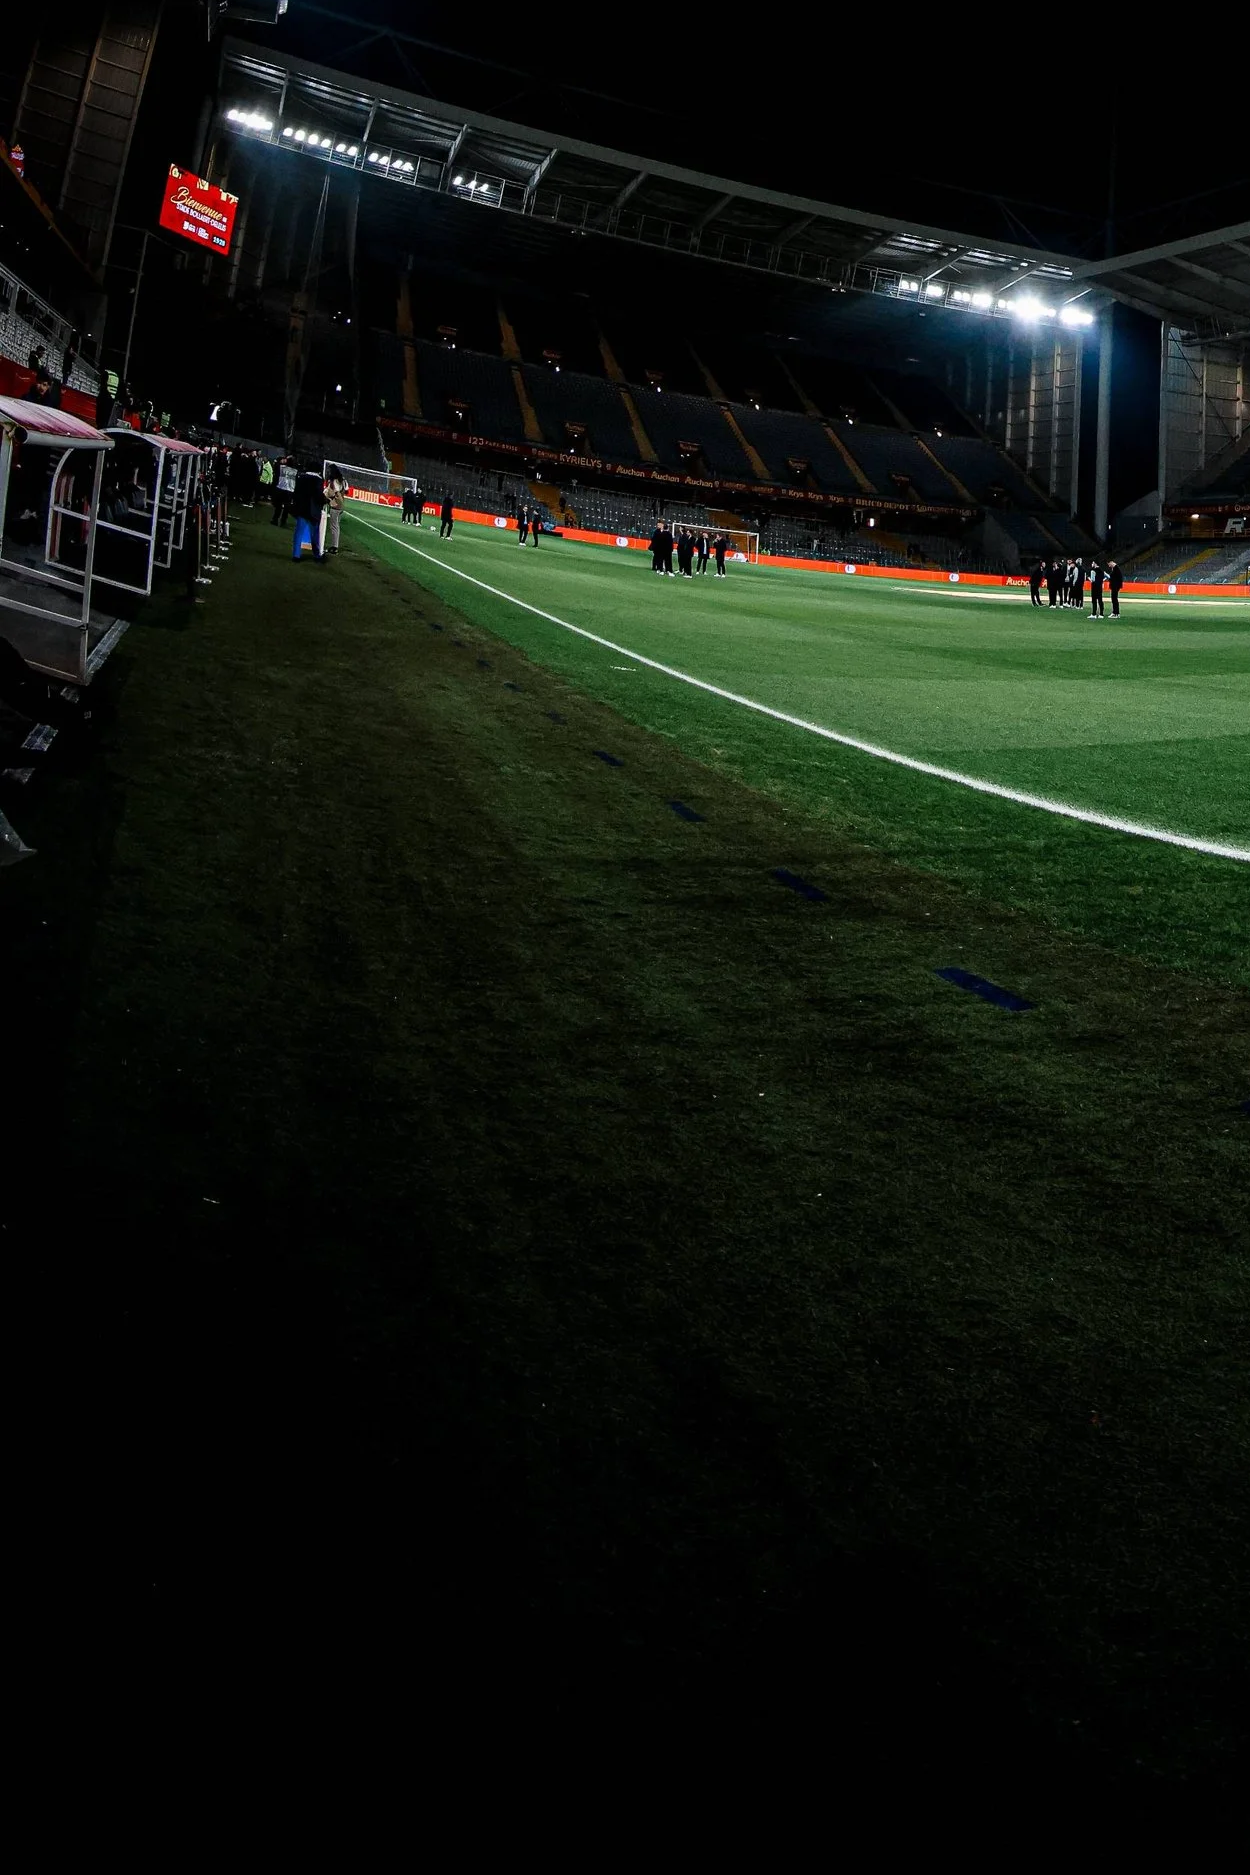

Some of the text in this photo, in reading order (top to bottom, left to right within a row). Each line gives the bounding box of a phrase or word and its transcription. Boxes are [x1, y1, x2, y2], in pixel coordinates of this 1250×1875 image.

[170, 187, 223, 220] Bienvenue
[468, 436, 484, 446] 123
[559, 454, 602, 469] KYRIELYS
[616, 465, 645, 478] Auchan
[650, 471, 680, 483] Auchan
[684, 476, 714, 488] Auchan
[352, 489, 380, 504] PUMA
[1005, 576, 1030, 587] Aucha
